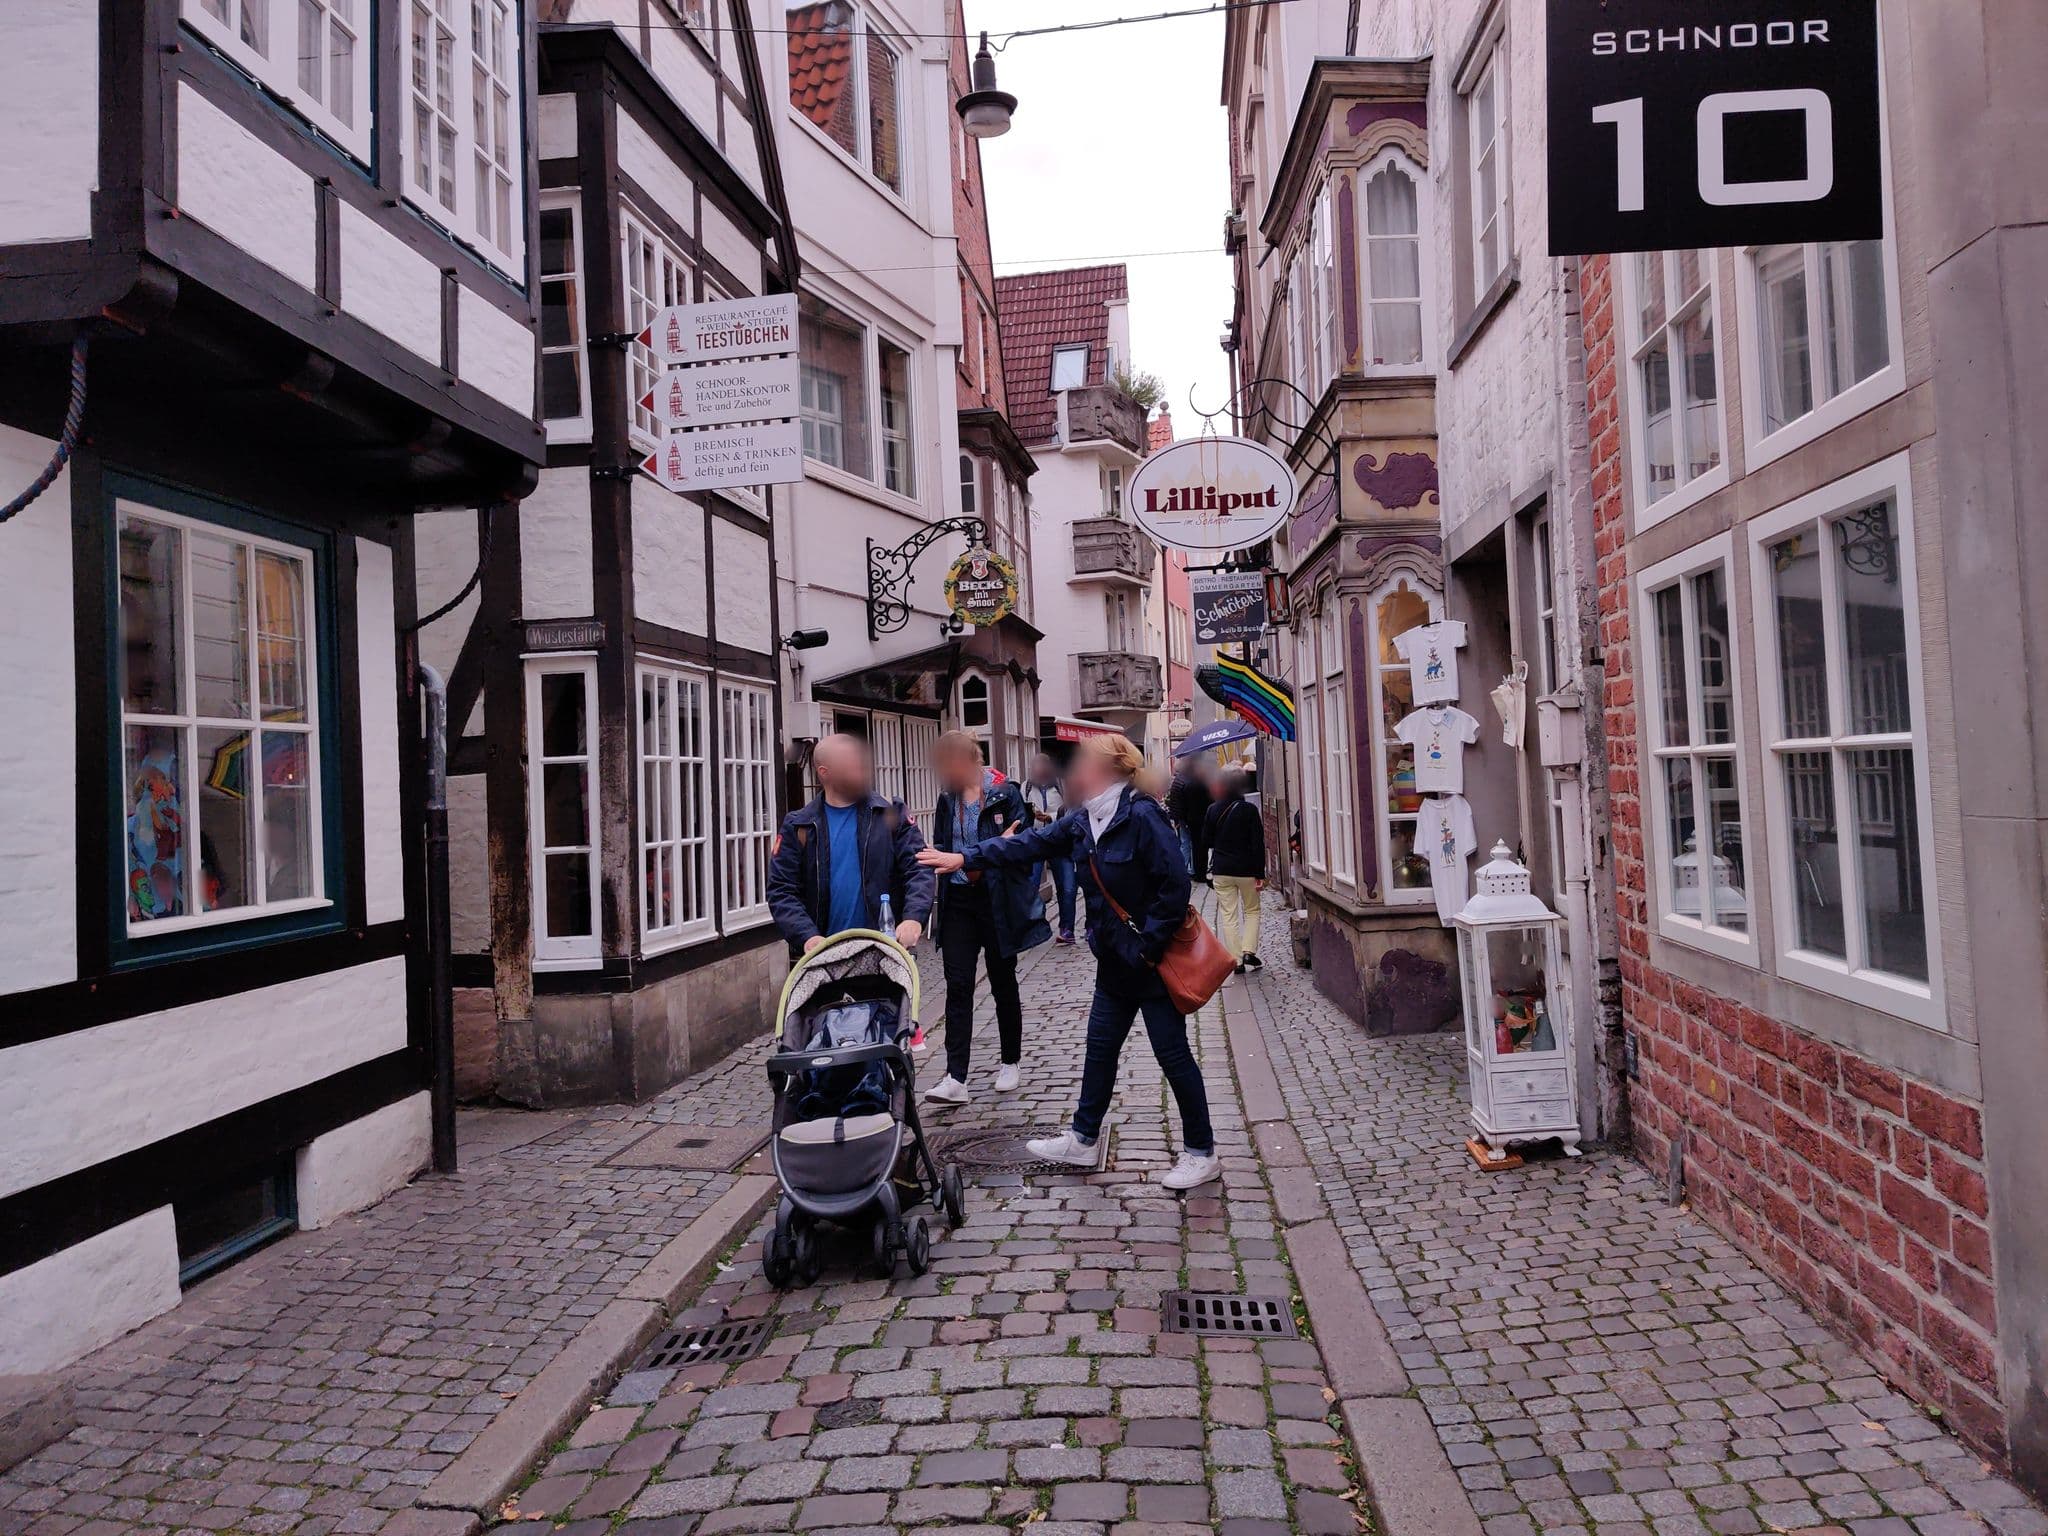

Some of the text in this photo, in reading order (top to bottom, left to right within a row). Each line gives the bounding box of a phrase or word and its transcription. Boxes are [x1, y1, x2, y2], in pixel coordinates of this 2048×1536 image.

[1592, 19, 1830, 55] SCHNOOR
[1592, 88, 1834, 212] 10
[695, 304, 789, 325] RESTAURANT CAFÉ
[706, 316, 778, 332] WEIN STUBE
[695, 376, 751, 389] SCHNOOR-
[696, 383, 791, 401] HANDELSKONTOR
[696, 397, 772, 413] Tee und Zubehör
[694, 437, 754, 451] BREMISCH
[695, 447, 797, 464] ESSEN & TRINKEN
[694, 461, 770, 478] deftig und fein
[1144, 484, 1281, 517] Lilliput
[1194, 582, 1262, 592] SOMMERGARTEN
[1221, 574, 1261, 583] RESTAURANT
